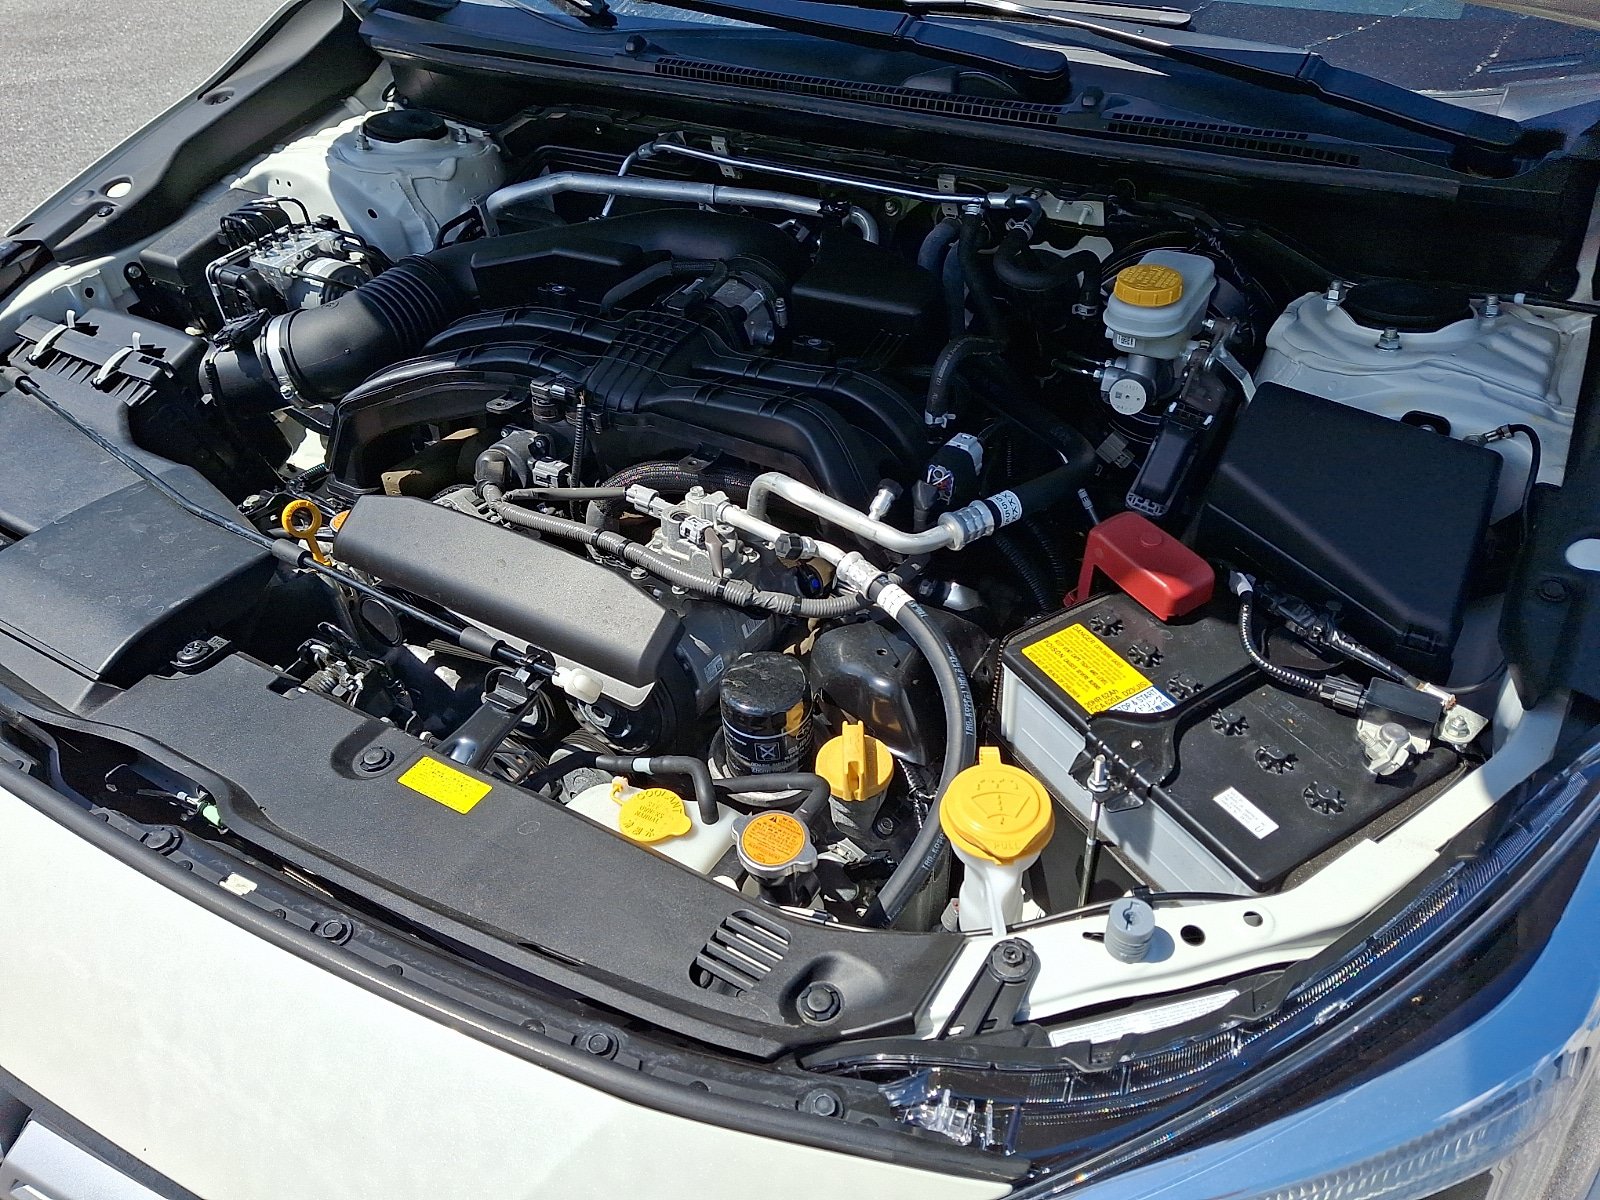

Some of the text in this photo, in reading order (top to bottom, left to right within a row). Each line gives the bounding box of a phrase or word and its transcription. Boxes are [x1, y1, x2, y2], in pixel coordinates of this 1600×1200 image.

[1071, 625, 1096, 644] DANGER
[1042, 639, 1065, 658] POISON
[637, 789, 682, 814] COOLANT
